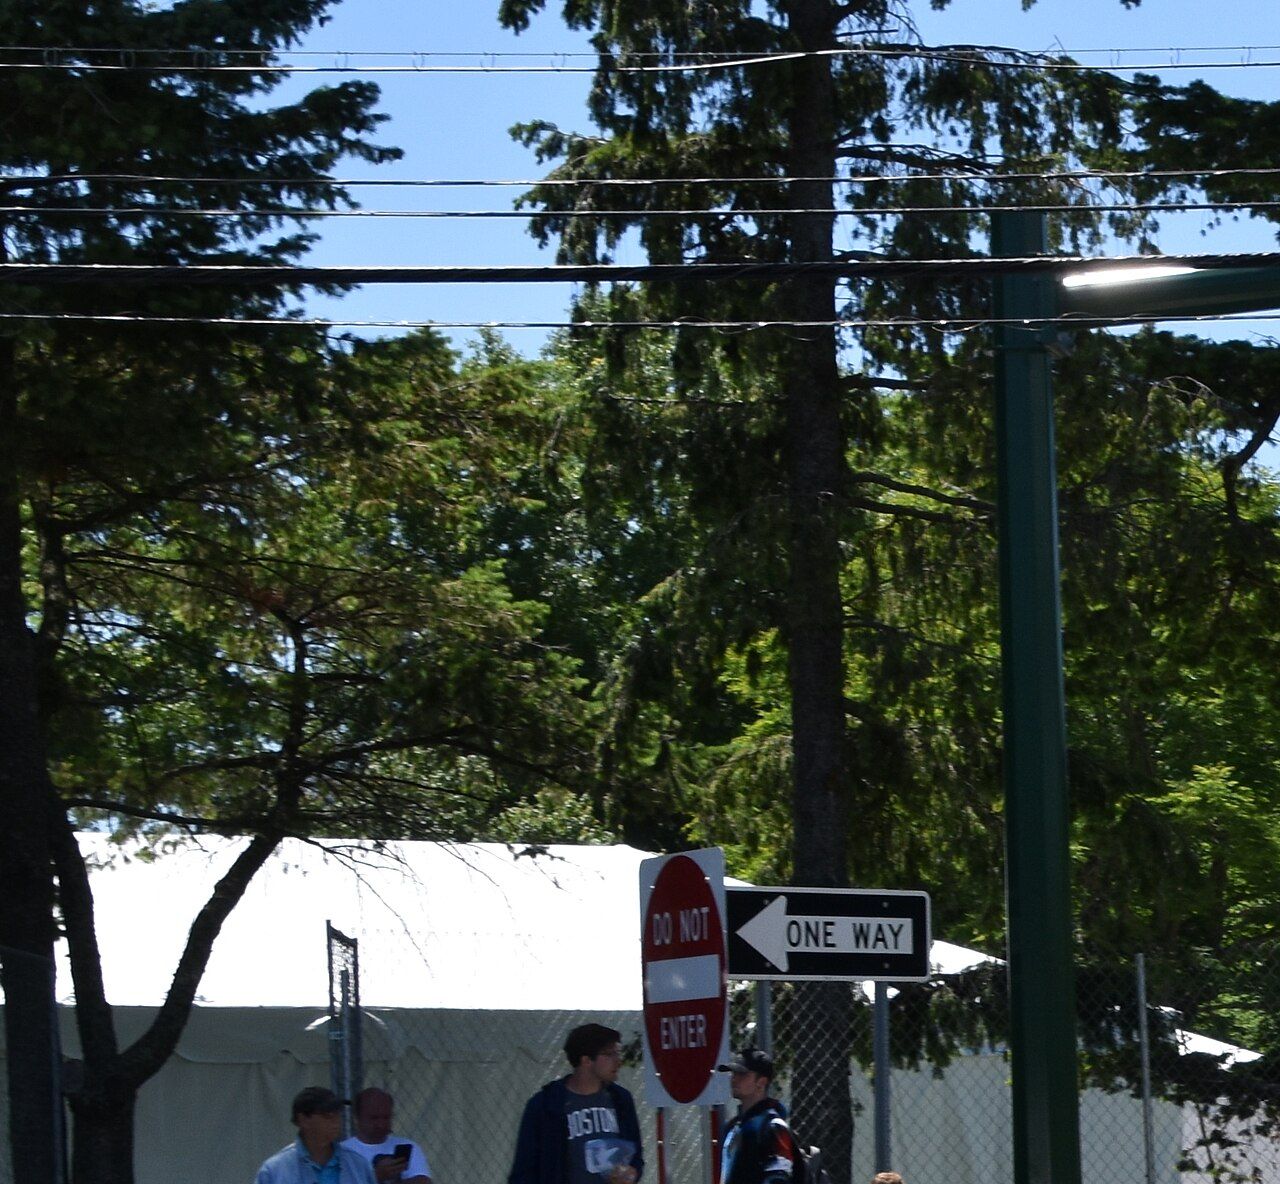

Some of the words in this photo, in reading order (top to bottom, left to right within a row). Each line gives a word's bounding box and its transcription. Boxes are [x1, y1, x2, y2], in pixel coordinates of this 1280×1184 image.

[653, 912, 672, 945] DO
[680, 907, 709, 943] NOT
[787, 920, 836, 948] ONE
[852, 922, 904, 950] WAY
[661, 1014, 707, 1050] ENTER
